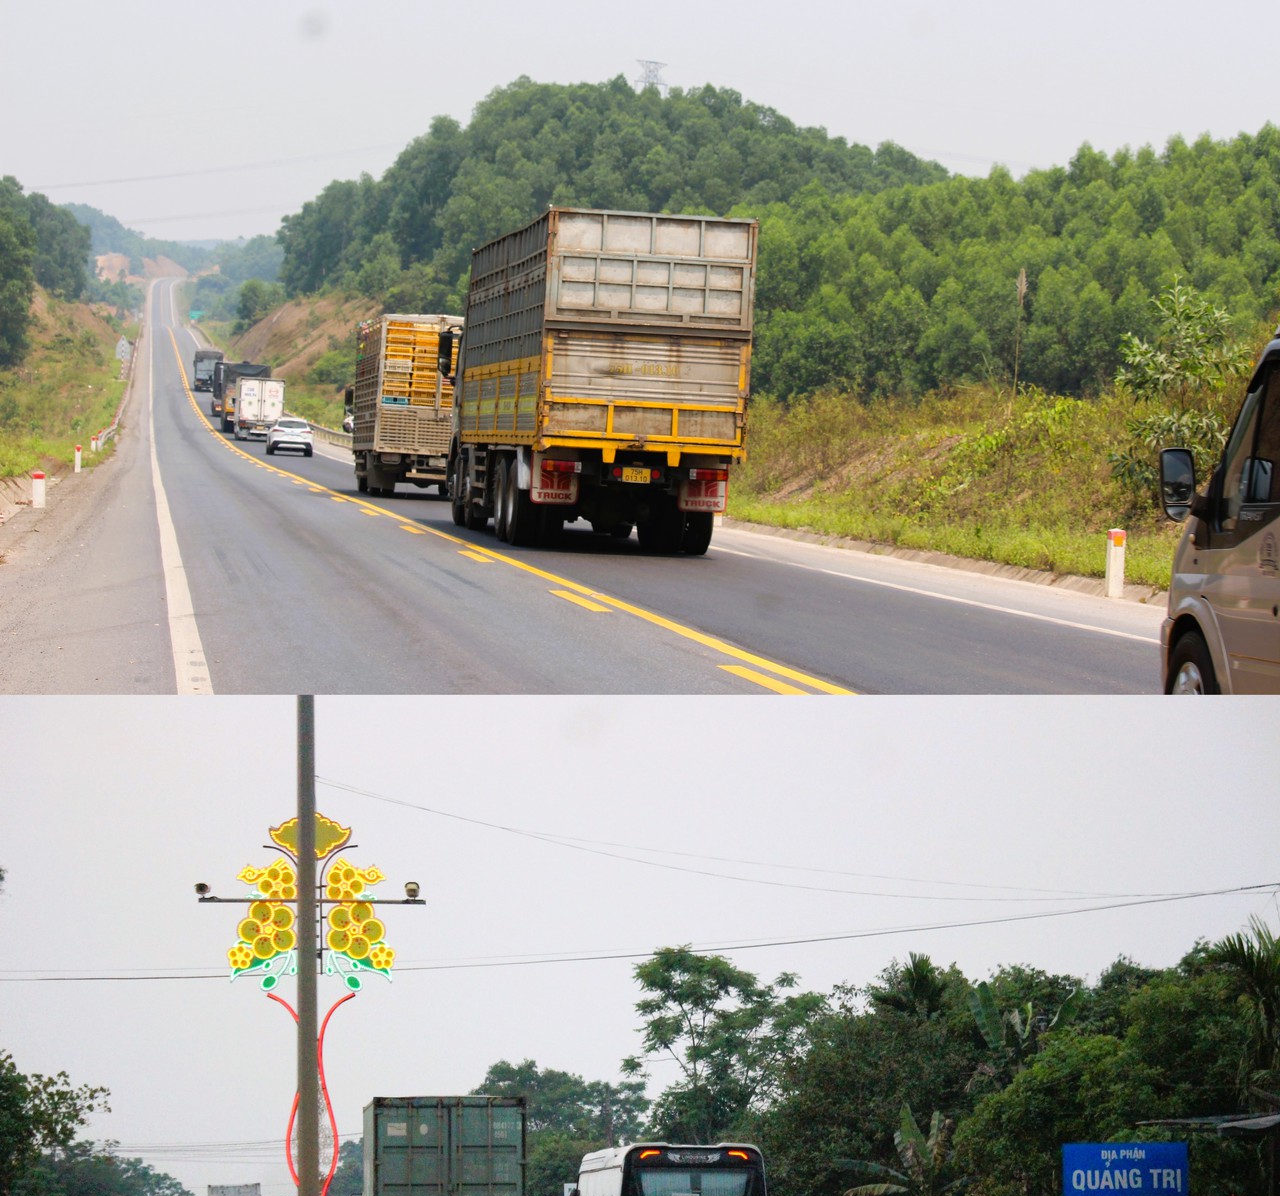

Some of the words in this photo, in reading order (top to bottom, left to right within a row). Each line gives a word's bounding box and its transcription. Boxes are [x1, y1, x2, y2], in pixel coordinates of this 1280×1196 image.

[537, 491, 572, 500] TRUCK
[684, 499, 720, 508] TRUCK
[1101, 1150, 1118, 1162] ĐỊA
[1120, 1148, 1145, 1161] PHẬN
[1072, 1162, 1142, 1191] QUẢNG
[1149, 1168, 1181, 1192] TRỊ
